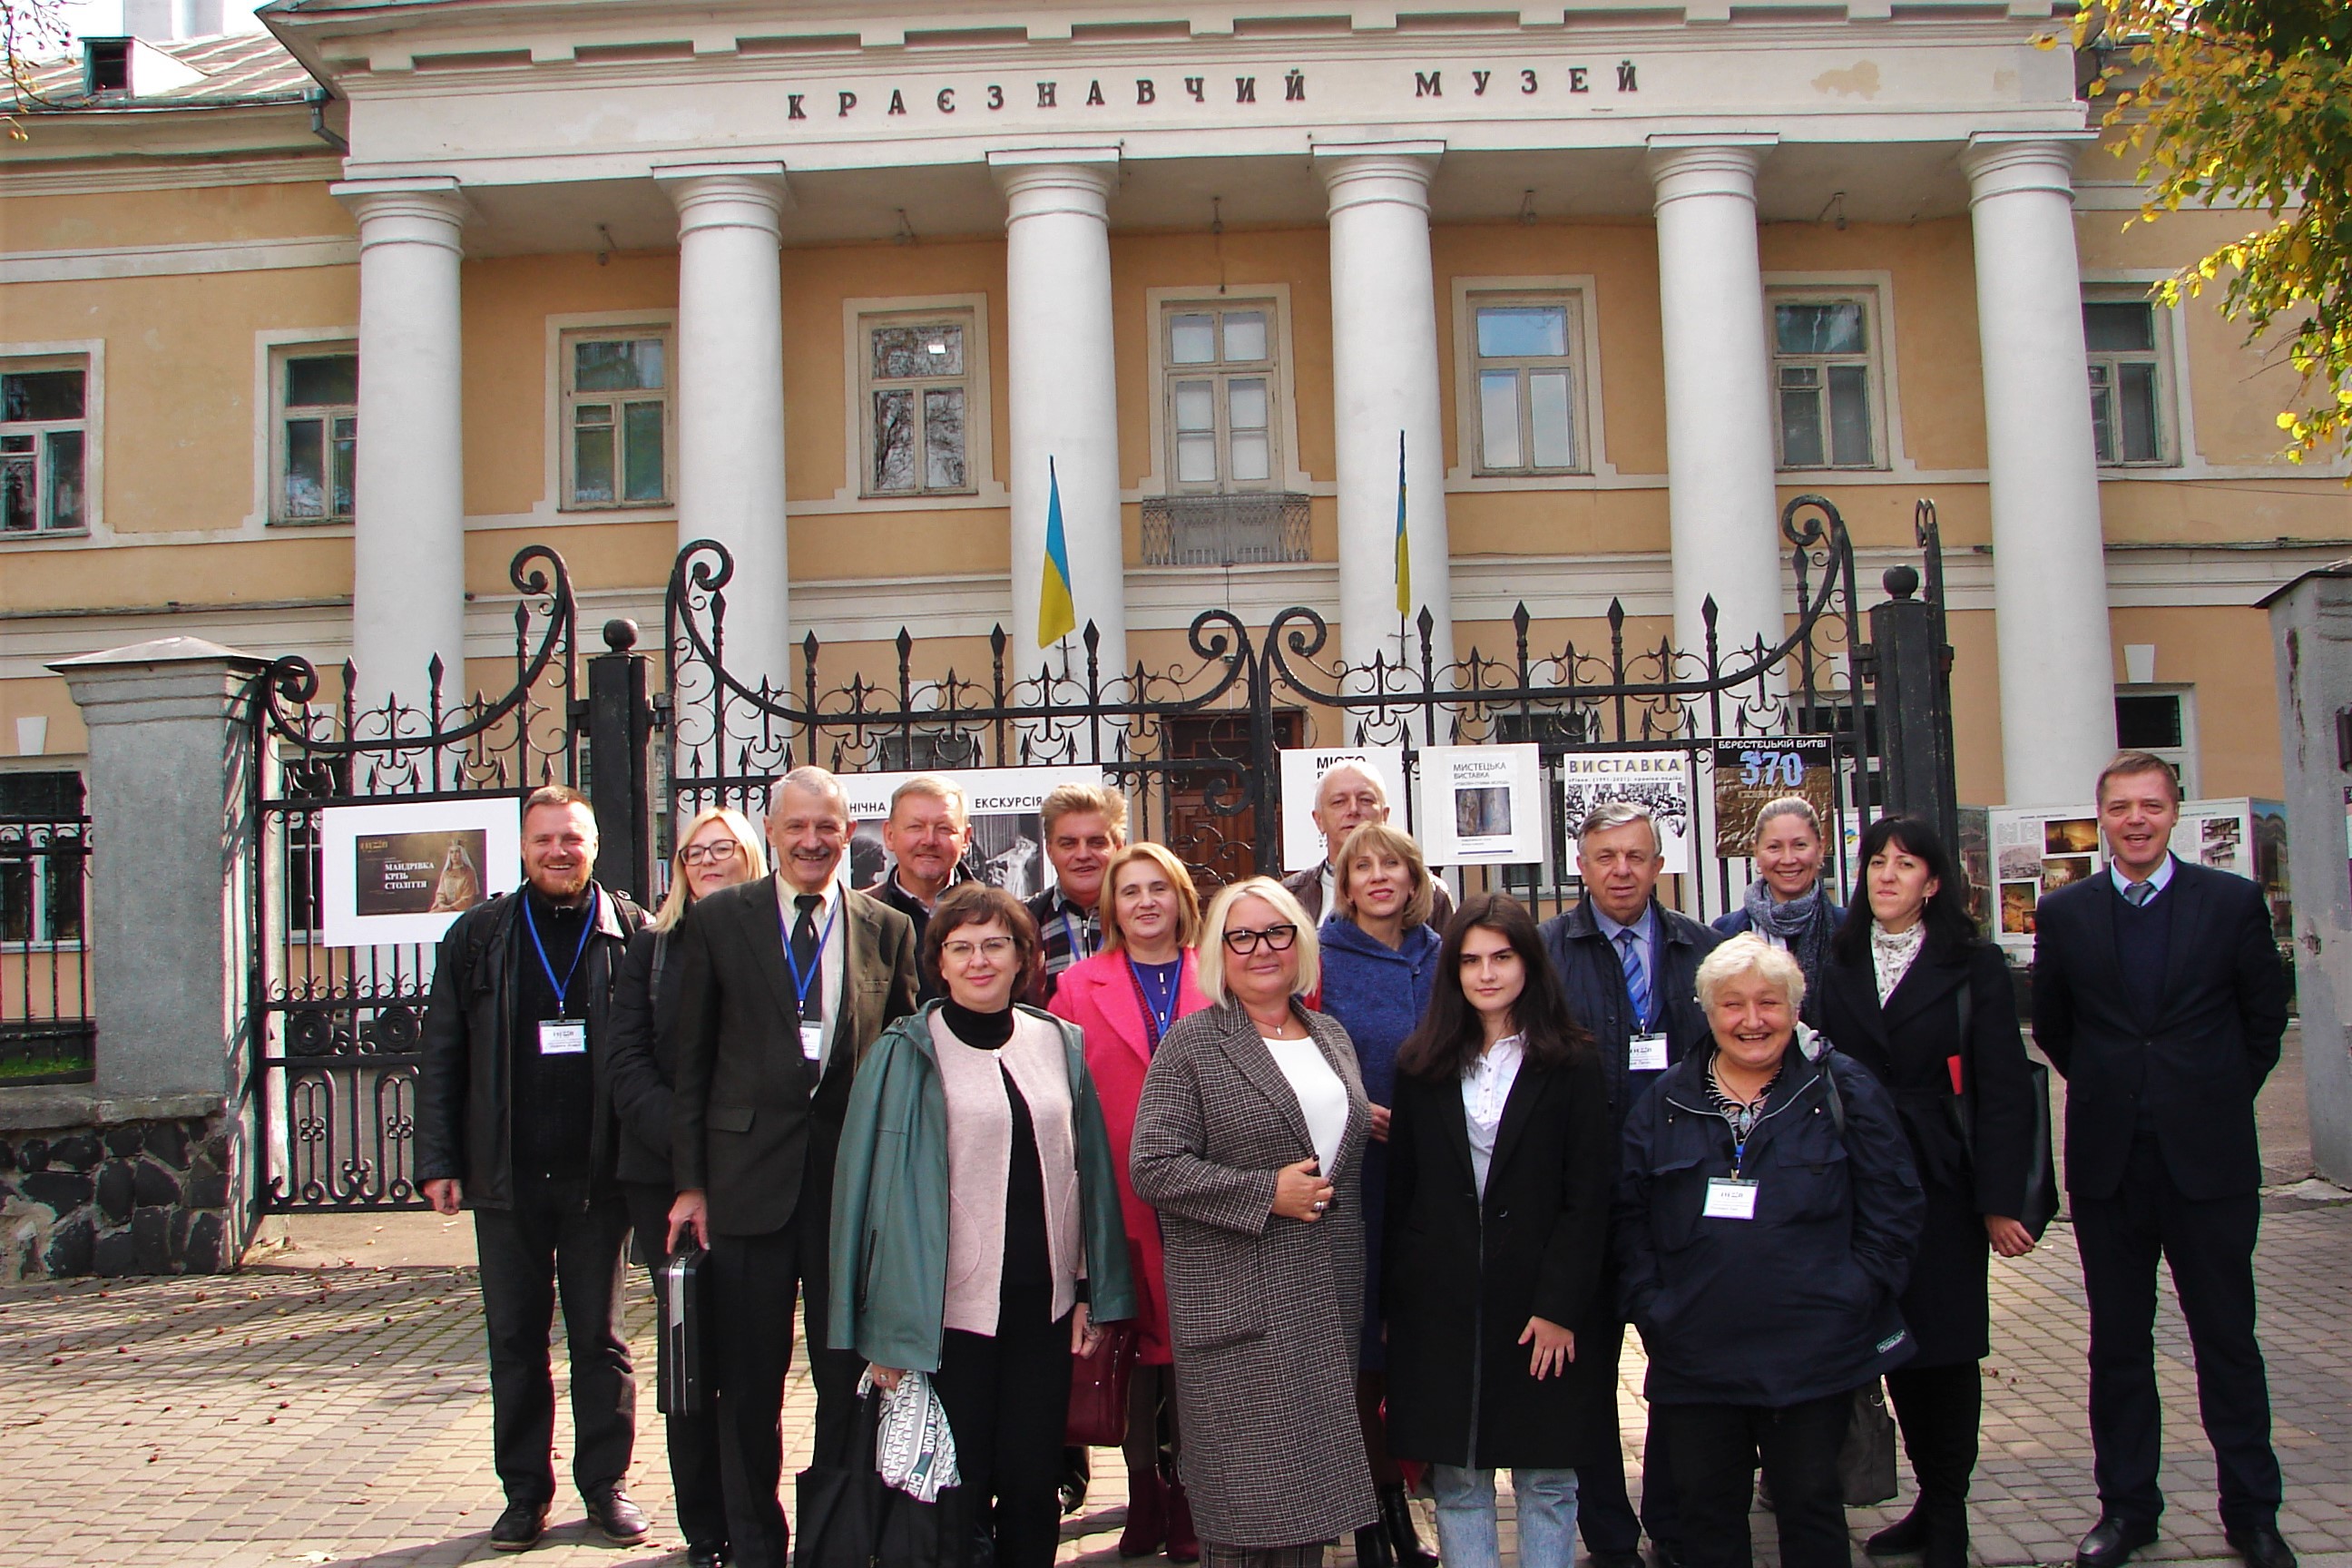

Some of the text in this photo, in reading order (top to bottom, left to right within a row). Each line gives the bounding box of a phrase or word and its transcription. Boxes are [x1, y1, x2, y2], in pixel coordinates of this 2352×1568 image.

[788, 60, 1638, 120] КРАЄЗНАВЧИЙ МУЗЕЙ
[1796, 739, 1827, 749] БИТВІ
[1454, 761, 1506, 771] МИСТЕЦЬКА
[1569, 758, 1681, 774] ВИСТАВКА
[1740, 750, 1804, 788] 370
[849, 796, 1043, 813] НІЧНА ЕКСКУРСІЯ
[385, 862, 435, 870] МАНДРІВКА
[385, 880, 426, 889] СТОЛІТТЯ
[922, 1426, 936, 1454] DIOR
